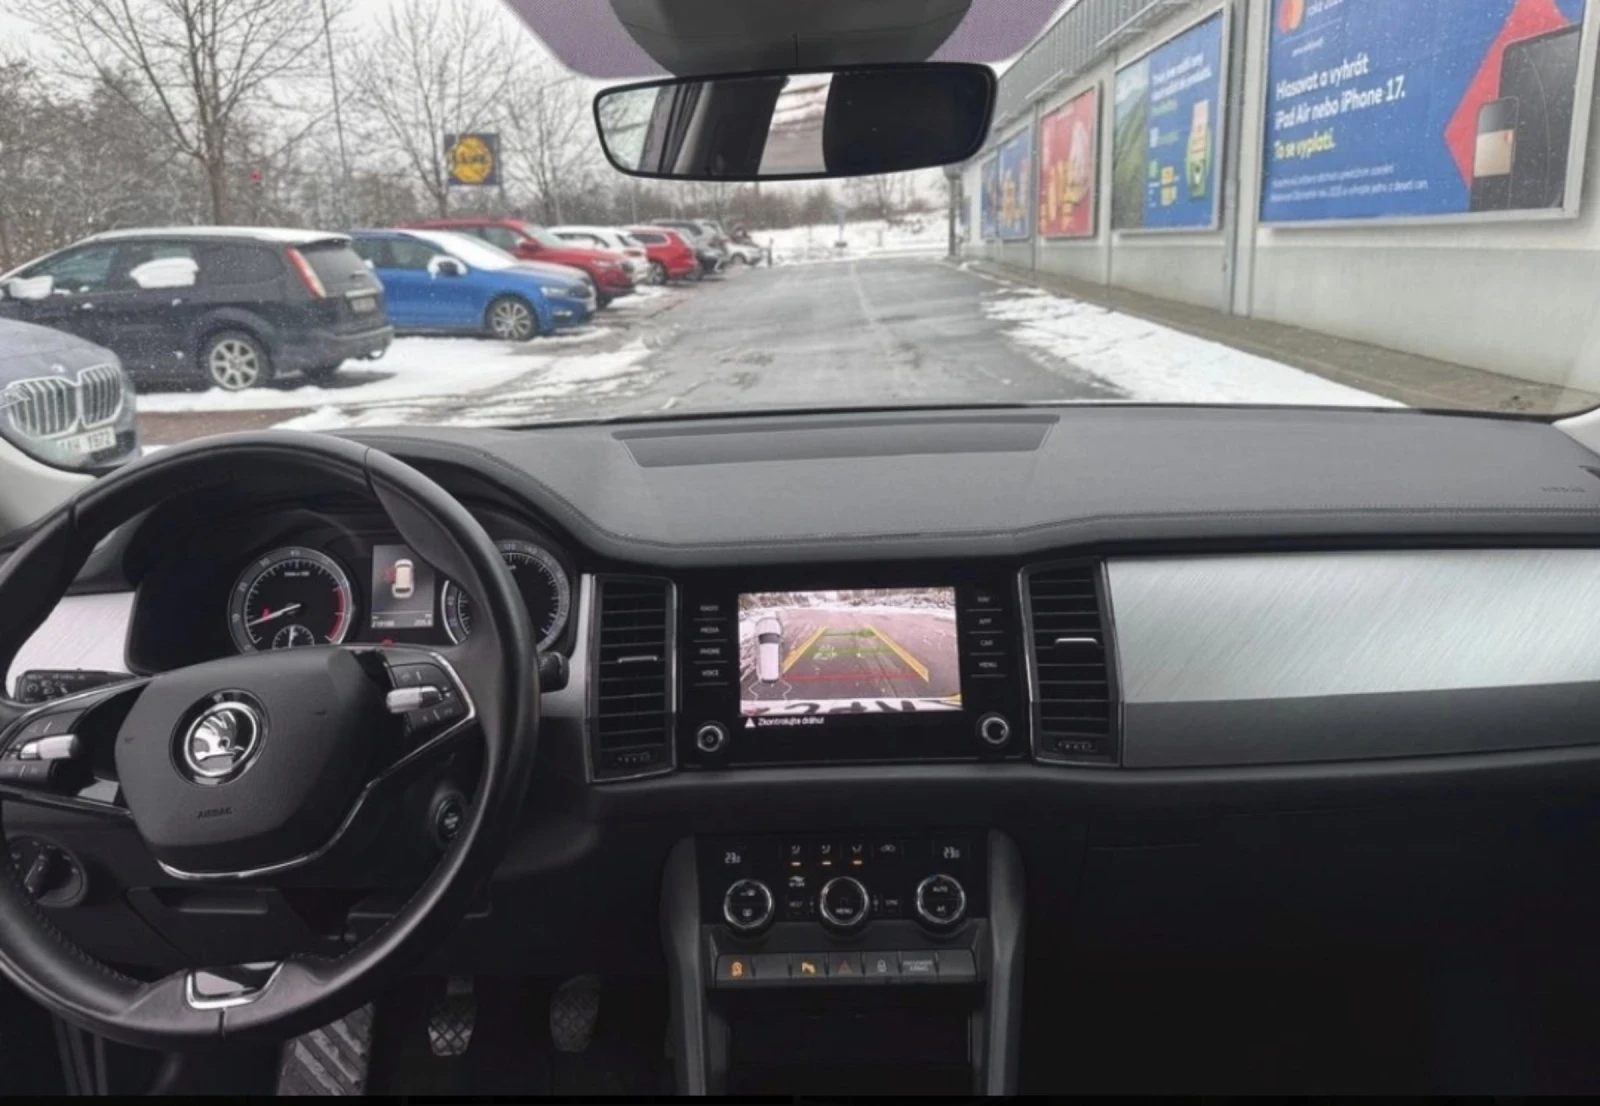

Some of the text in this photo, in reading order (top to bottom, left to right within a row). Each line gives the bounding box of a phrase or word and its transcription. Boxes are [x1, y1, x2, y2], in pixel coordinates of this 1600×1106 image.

[1276, 52, 1369, 100] Hlasovat a vyhrát
[1275, 75, 1406, 130] iPad Air nebo iPhone 17.
[1286, 142, 1295, 158] se
